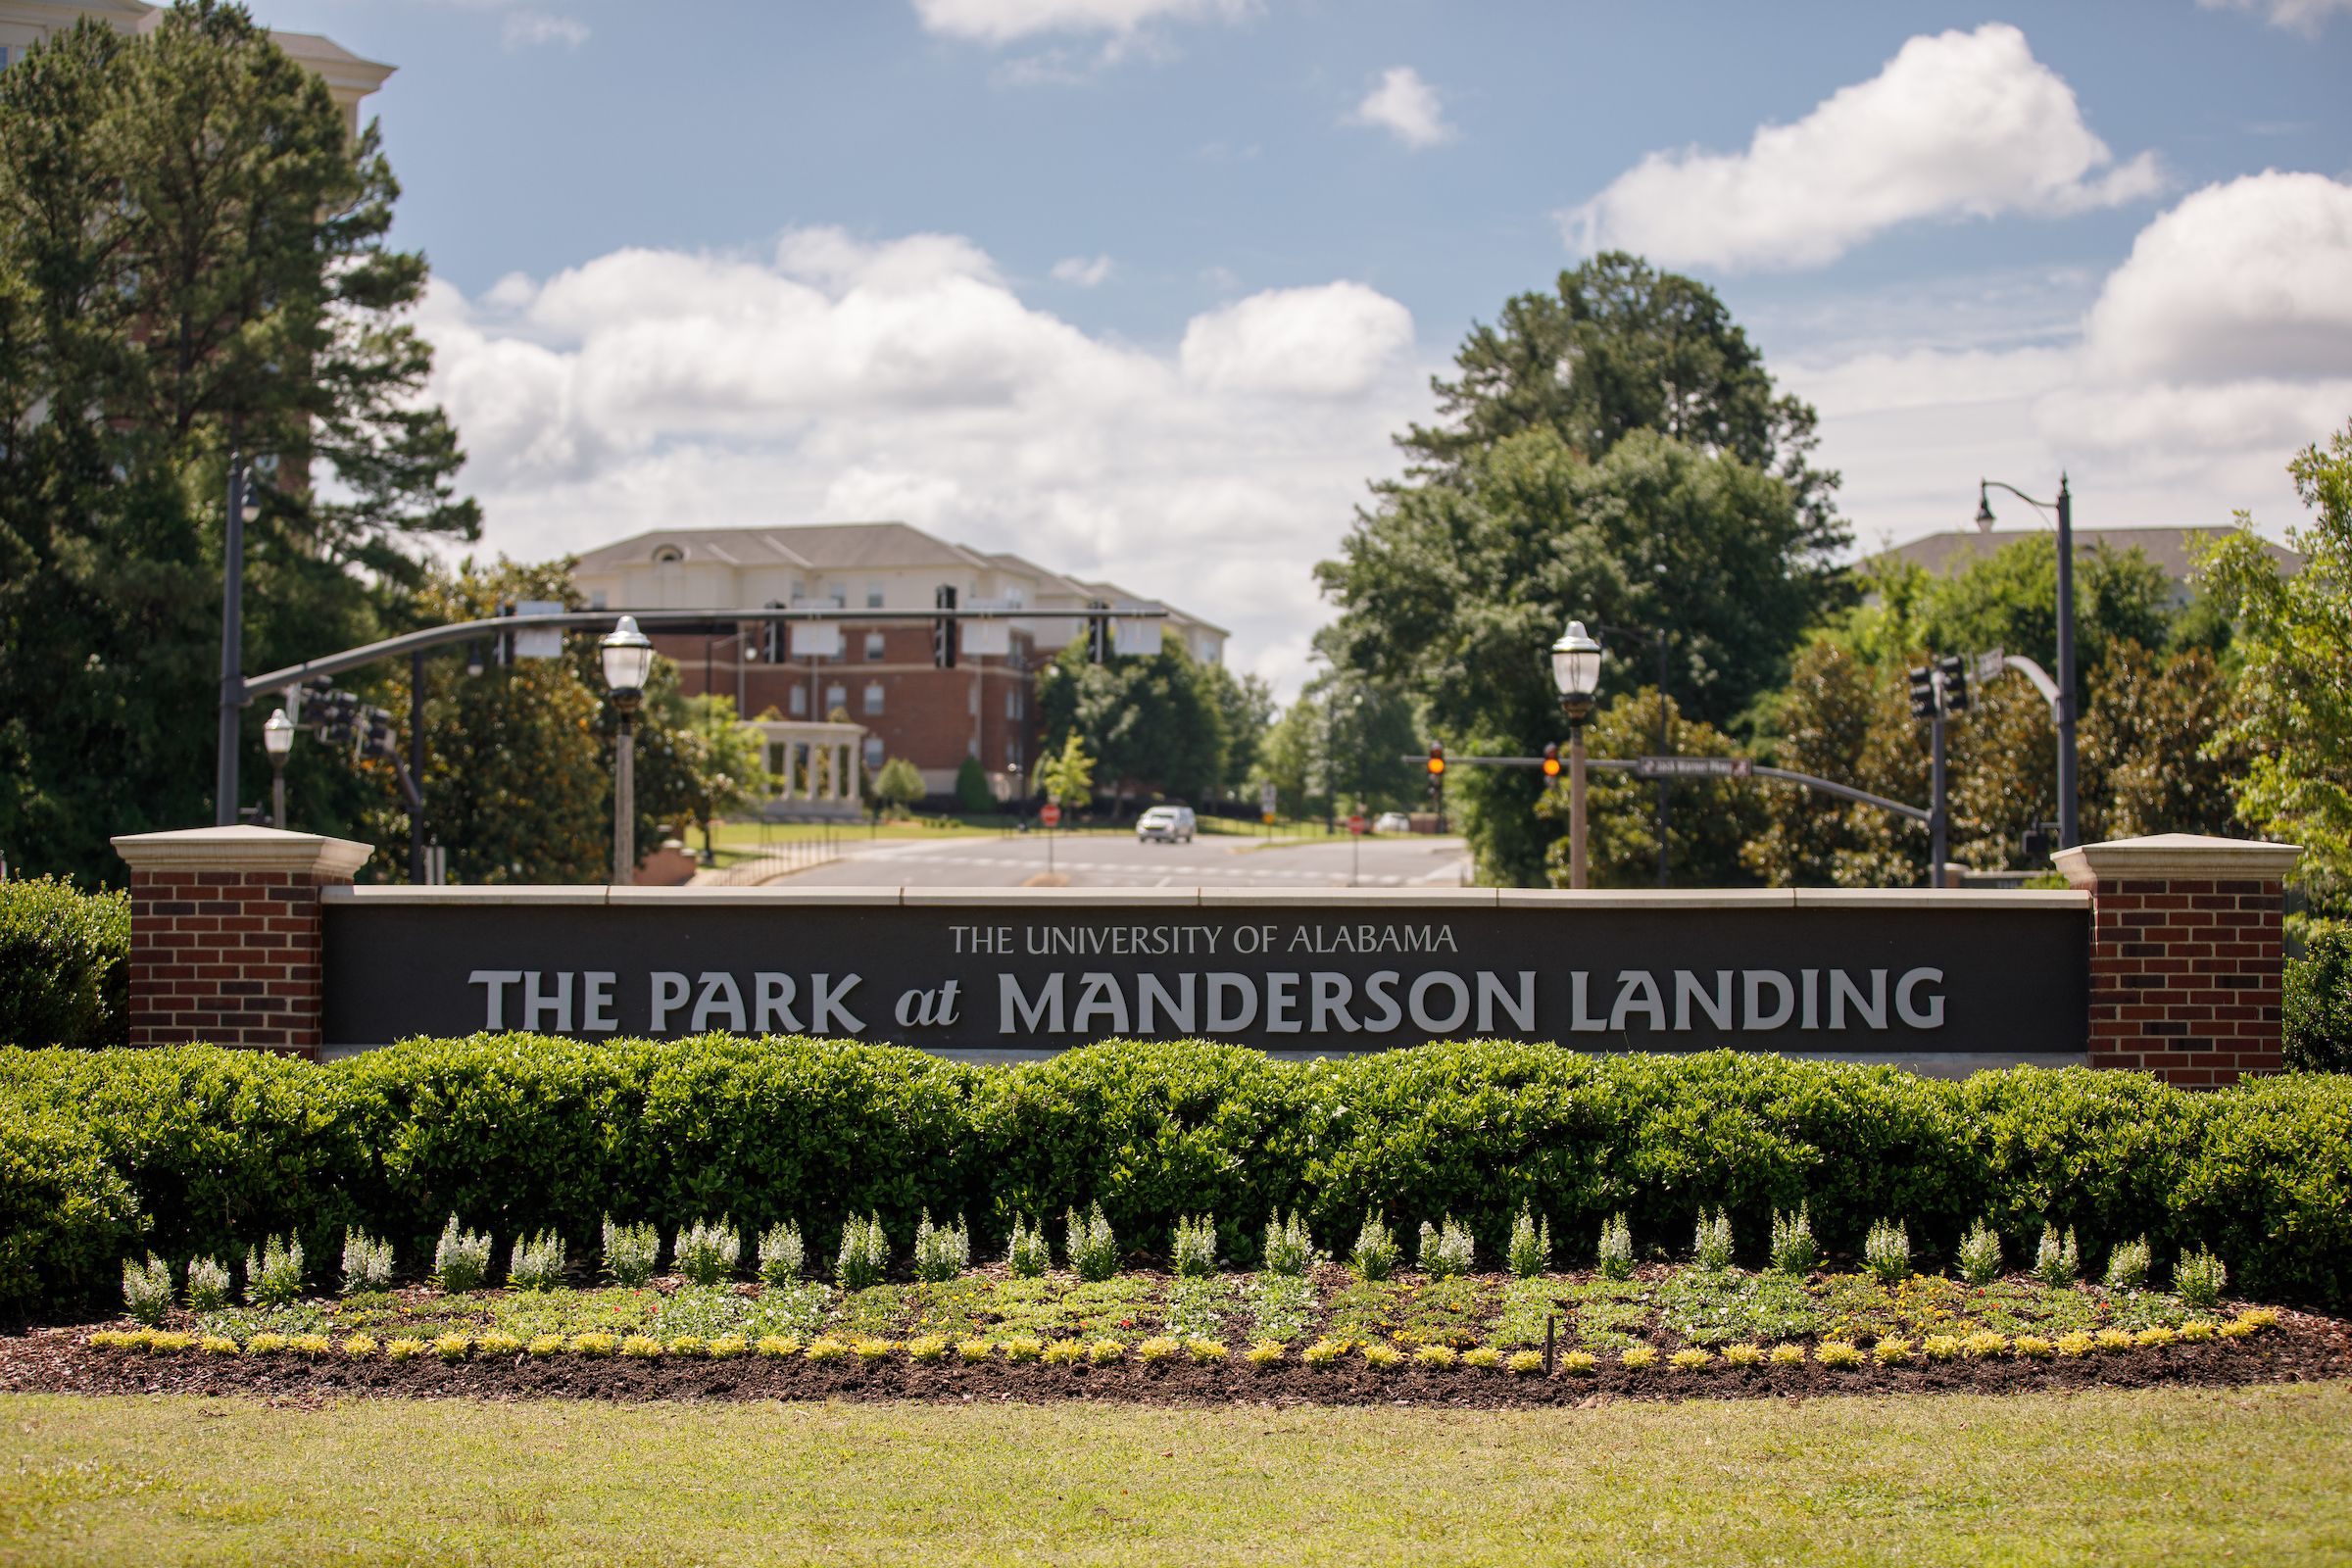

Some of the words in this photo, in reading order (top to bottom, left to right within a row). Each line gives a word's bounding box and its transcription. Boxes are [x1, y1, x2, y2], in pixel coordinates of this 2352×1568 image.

[949, 926, 1014, 955] THE
[1027, 925, 1224, 955] UNIVERSITY
[1233, 925, 1278, 954] OF
[1288, 924, 1459, 953] ALABAMA
[467, 970, 618, 1032] THE
[650, 971, 867, 1034] PARK
[894, 979, 961, 1028] at
[998, 970, 1537, 1034] MANDERSON
[1570, 966, 1946, 1031] LANDING
